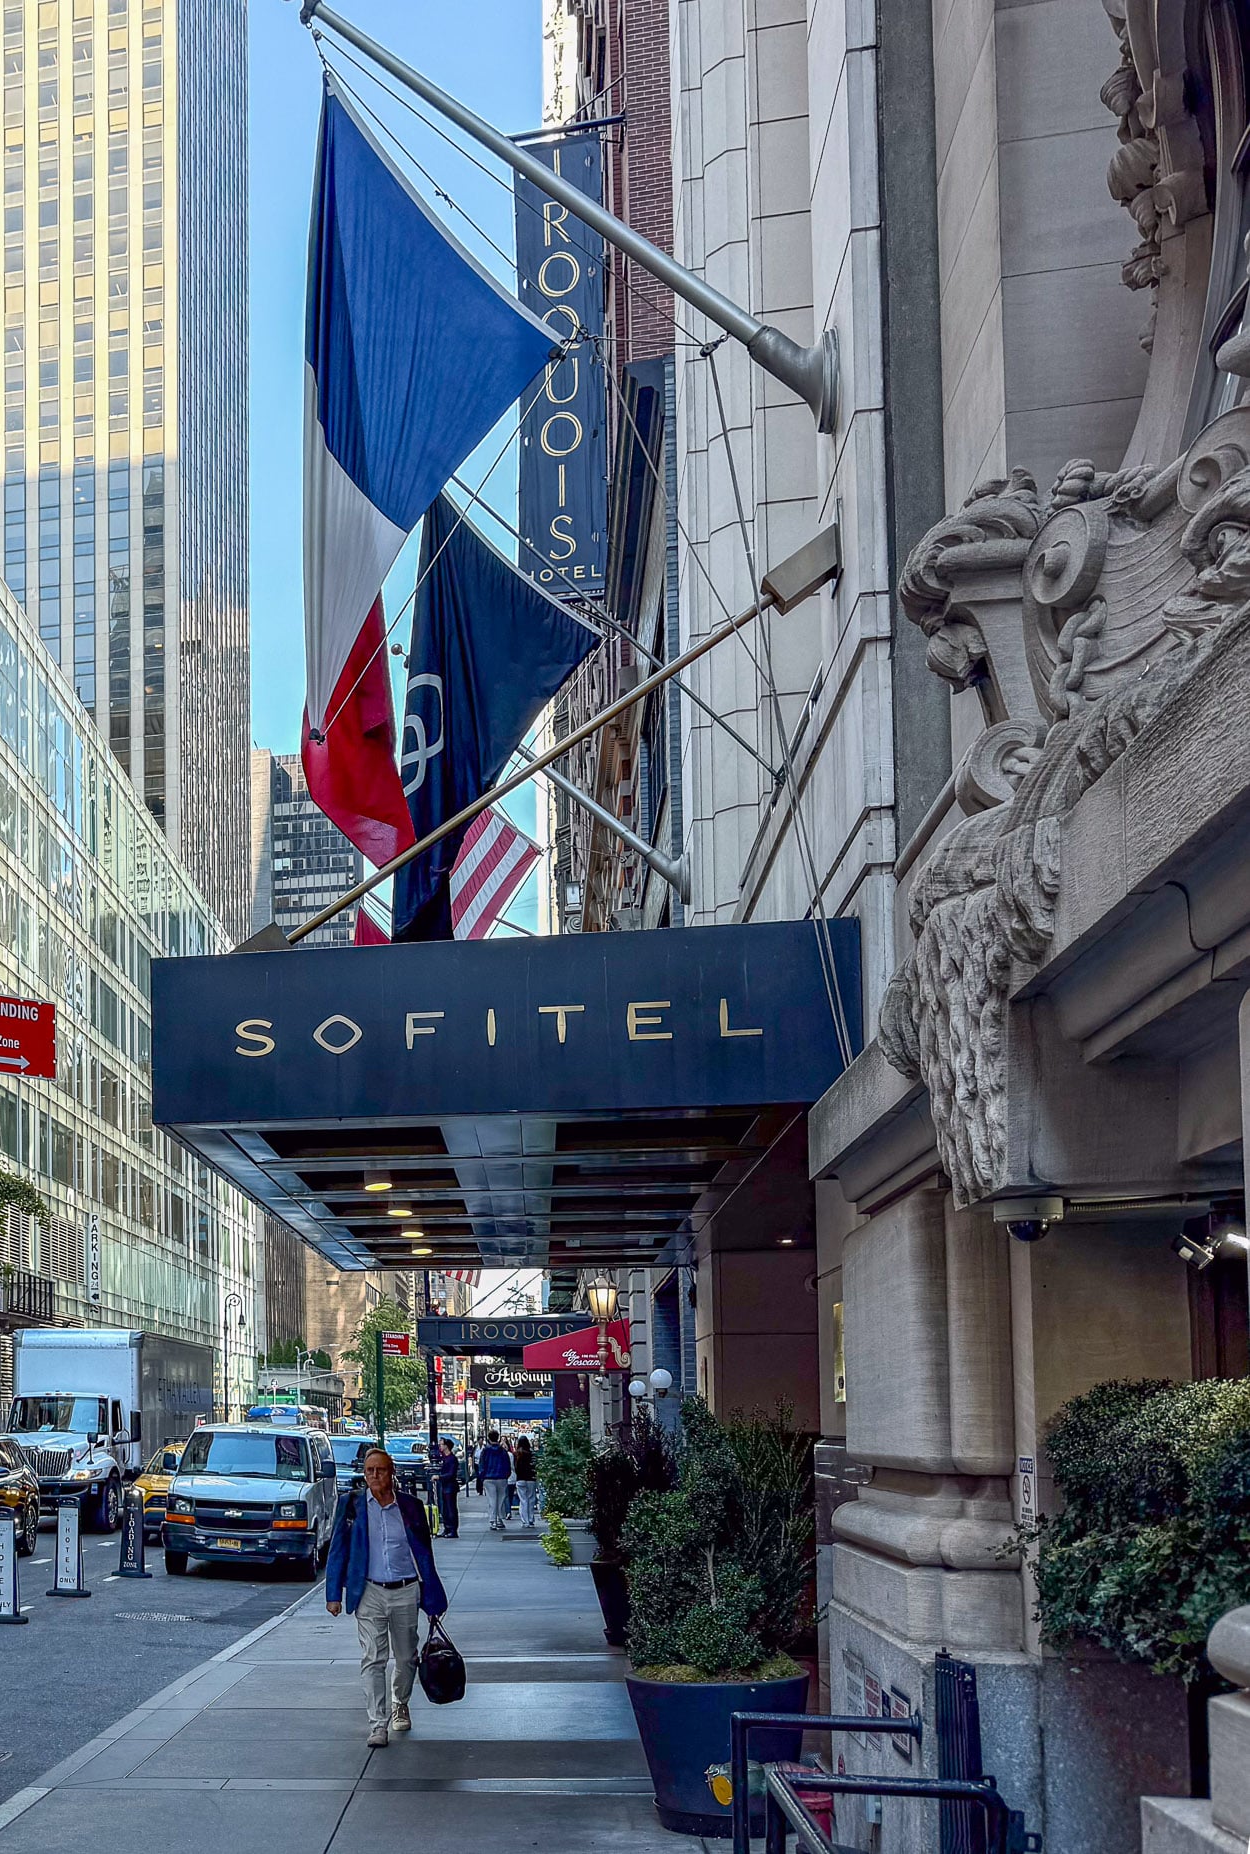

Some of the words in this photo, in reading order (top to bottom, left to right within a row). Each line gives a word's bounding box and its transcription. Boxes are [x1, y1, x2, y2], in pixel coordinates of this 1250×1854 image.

[235, 997, 763, 1057] SOFITEL
[91, 1214, 99, 1280] PARKING
[461, 1323, 574, 1340] IROQUOIS
[562, 1349, 576, 1358] da
[565, 1356, 600, 1367] Toscan
[484, 1367, 552, 1388] Algonqu
[127, 1512, 136, 1561] LOADING
[123, 1561, 138, 1569] ZONE
